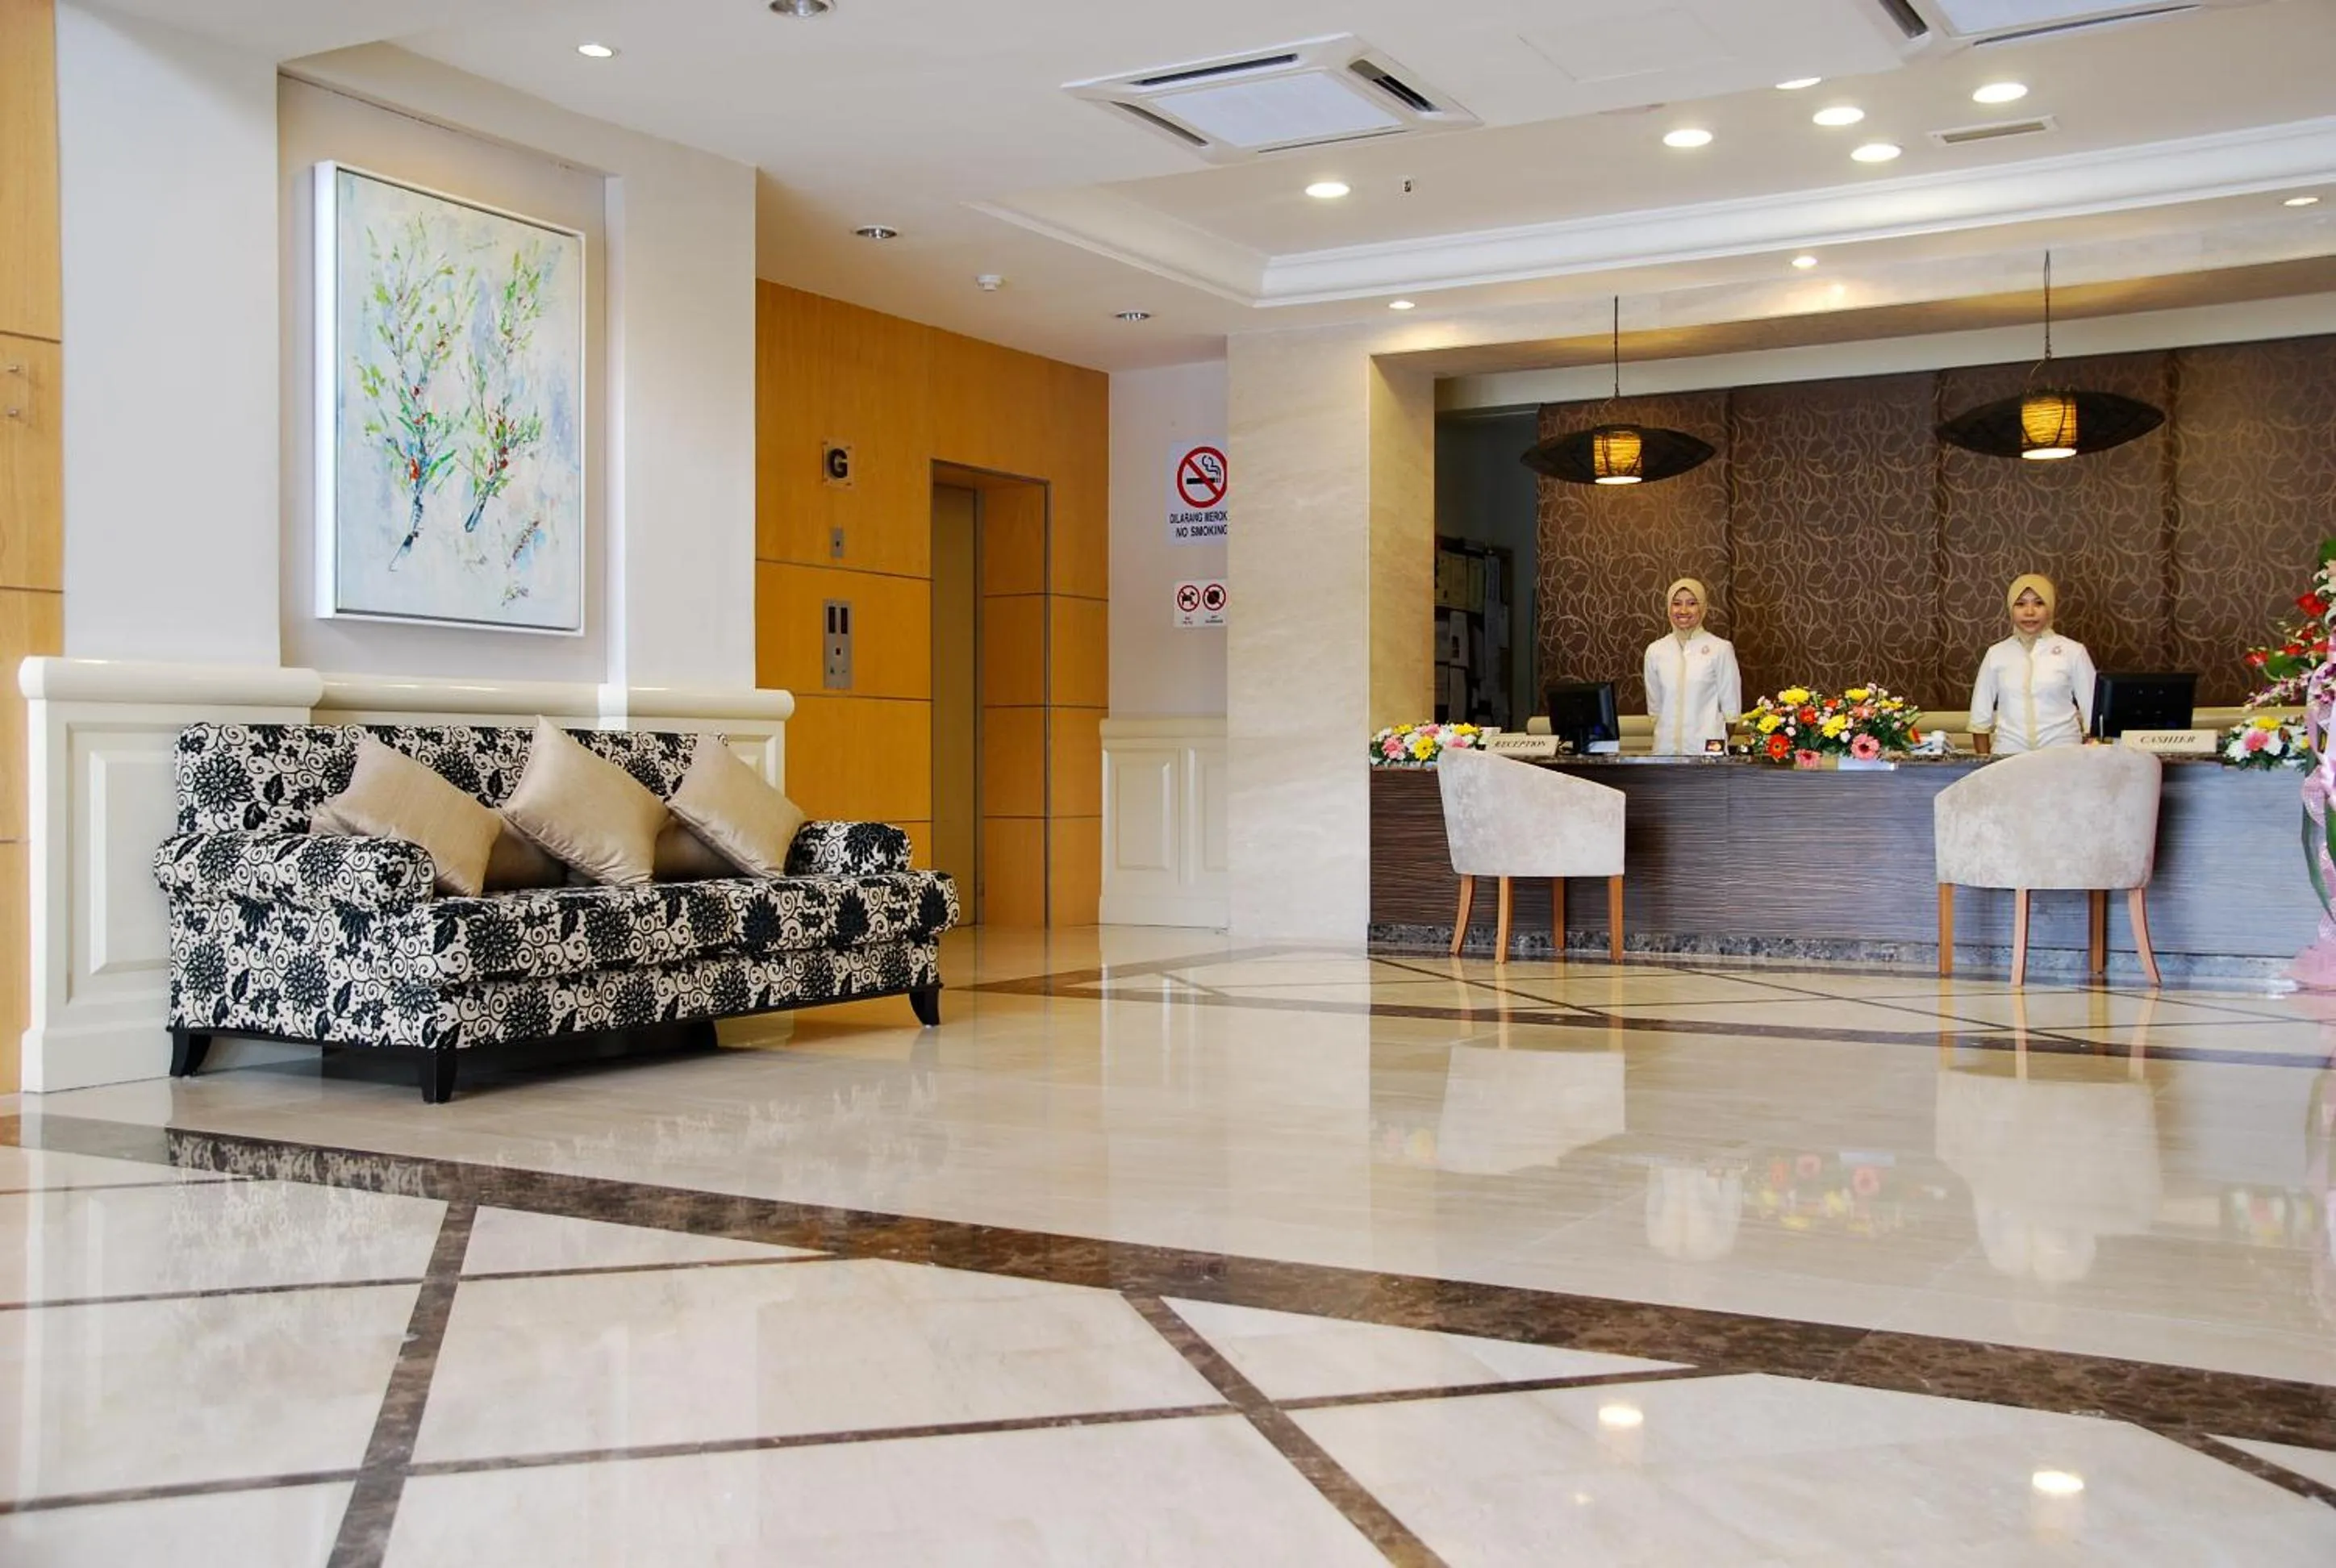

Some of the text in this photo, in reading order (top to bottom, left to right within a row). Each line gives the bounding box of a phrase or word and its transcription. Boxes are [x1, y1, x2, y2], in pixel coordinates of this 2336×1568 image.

[828, 448, 849, 479] G
[1170, 511, 1203, 523] DILARANG
[1175, 524, 1228, 538] NO SMOKING
[1494, 740, 1546, 748] RECEPTION
[2140, 736, 2196, 744] CASHIER
